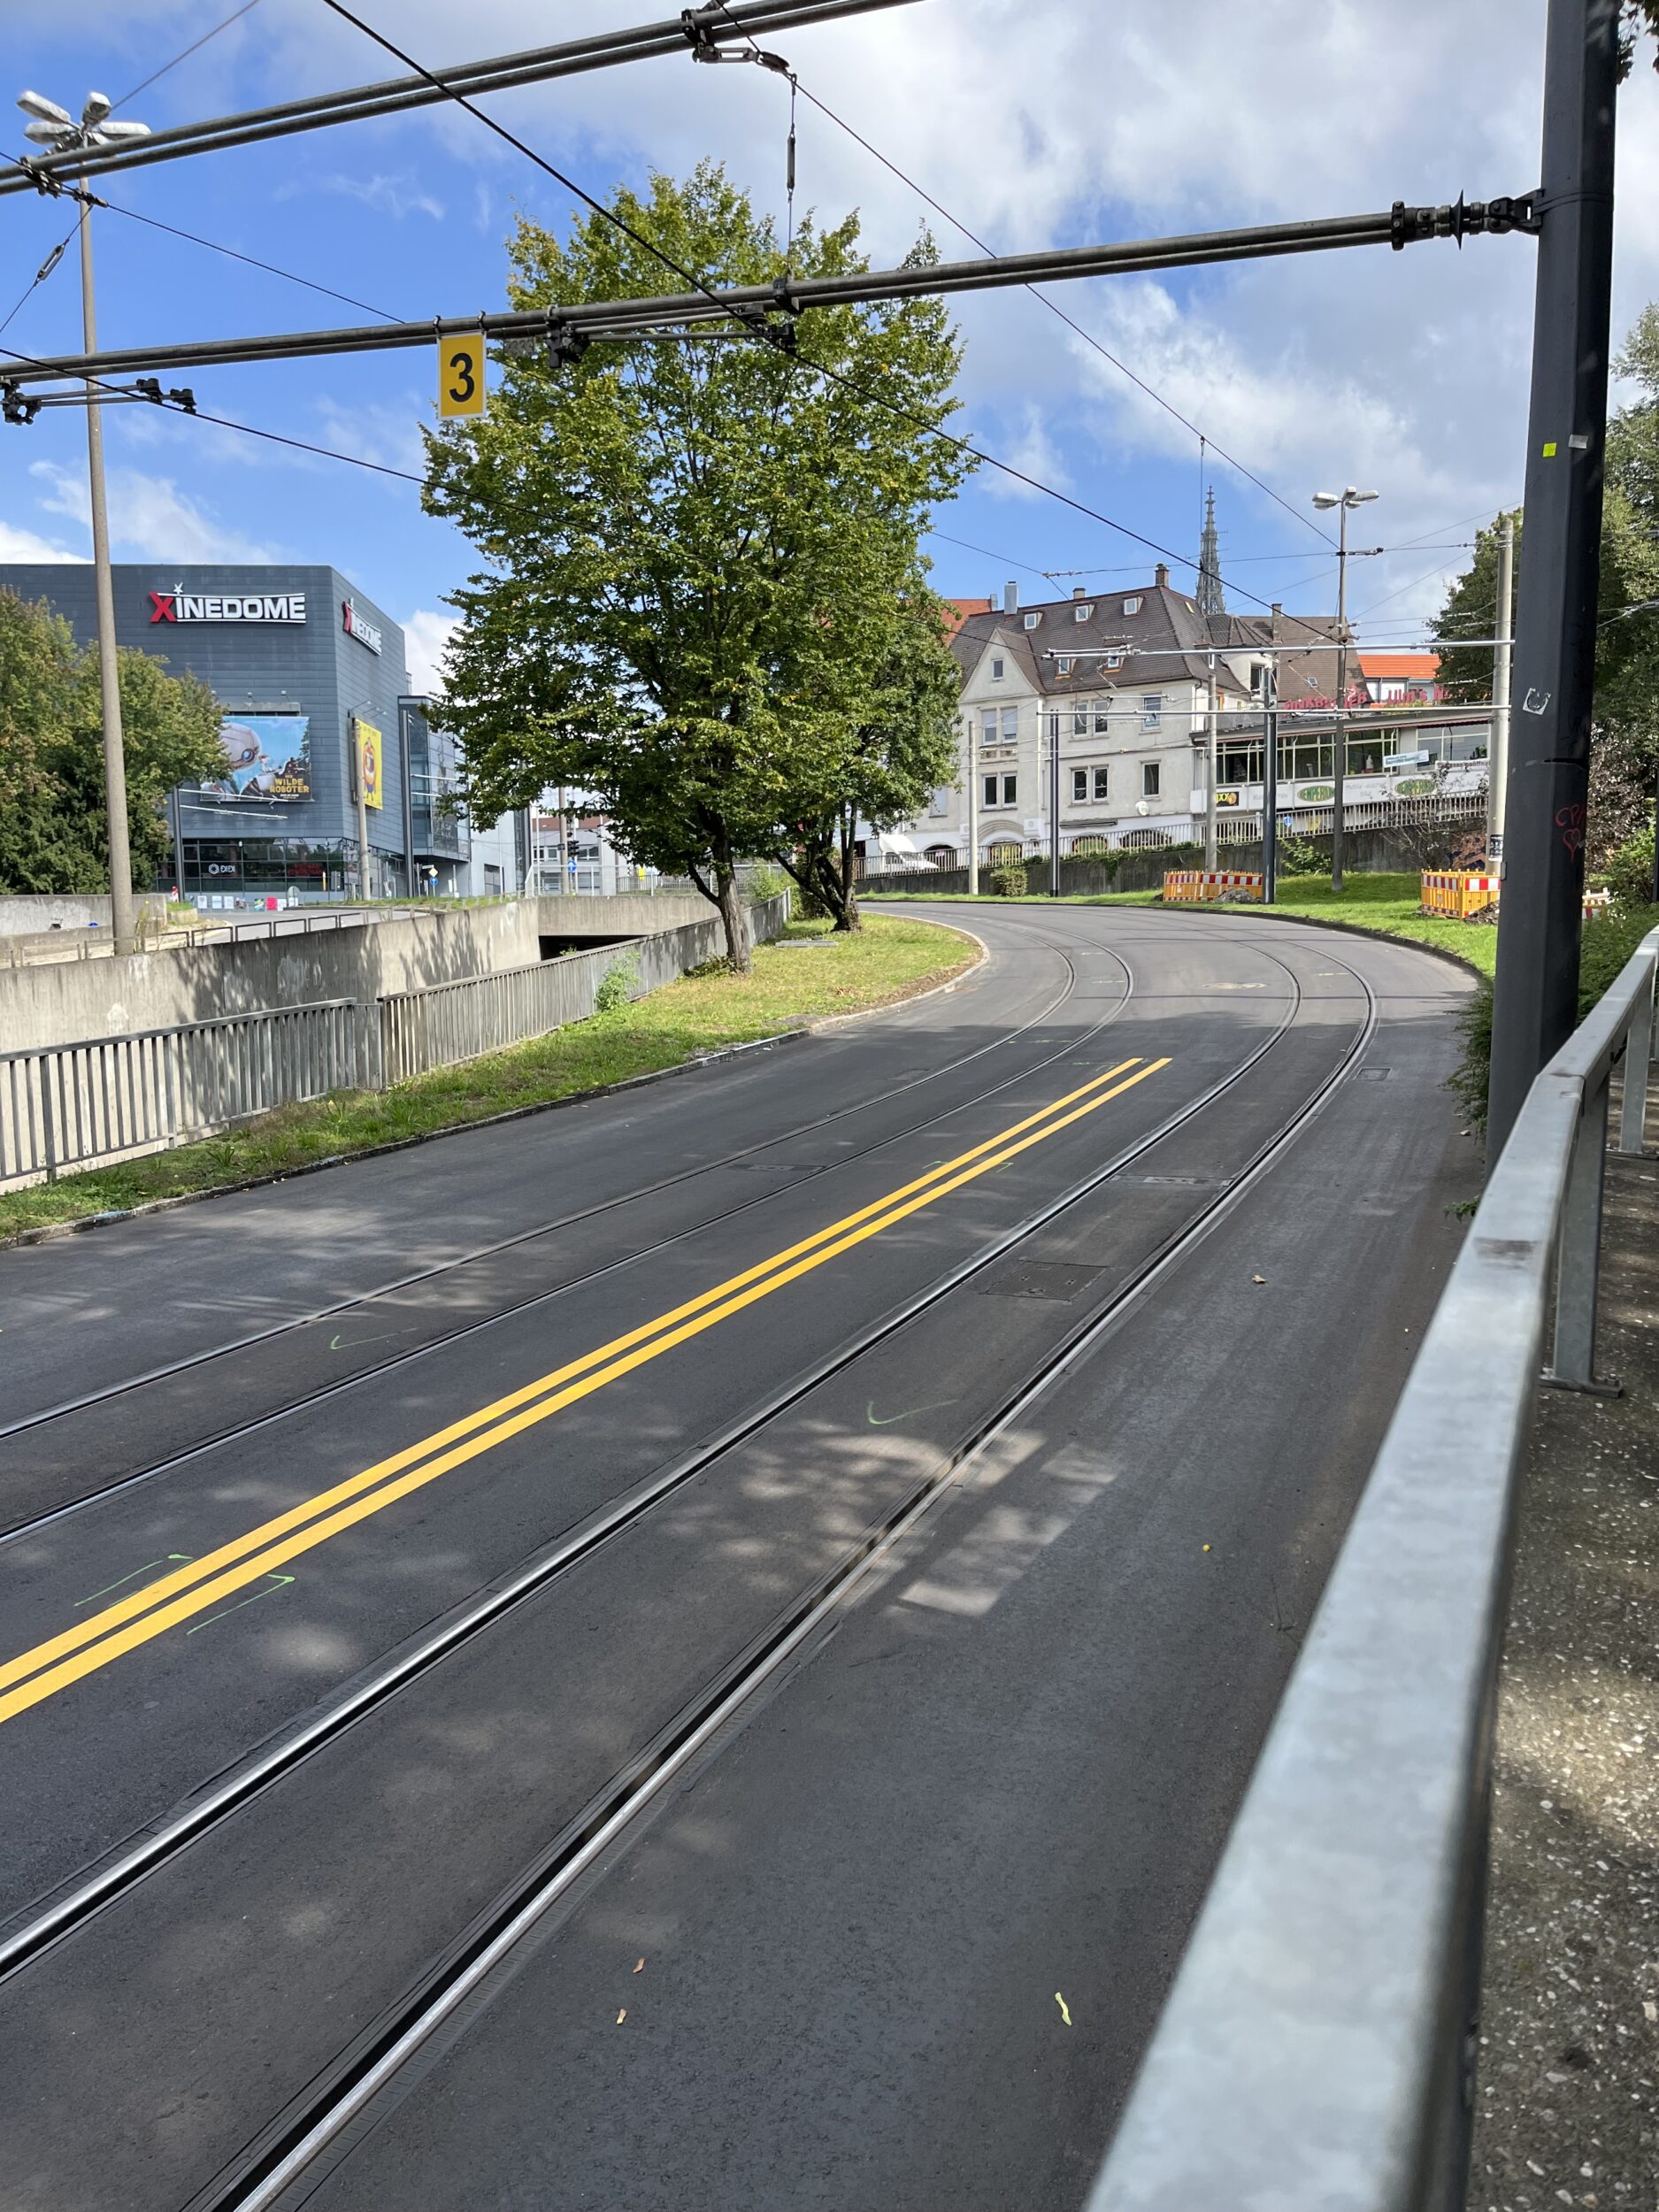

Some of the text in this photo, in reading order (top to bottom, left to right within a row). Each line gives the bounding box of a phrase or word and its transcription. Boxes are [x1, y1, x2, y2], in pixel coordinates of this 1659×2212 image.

[449, 352, 474, 403] 3
[149, 592, 307, 623] XINEDOME
[269, 785, 310, 794] ROBOTER
